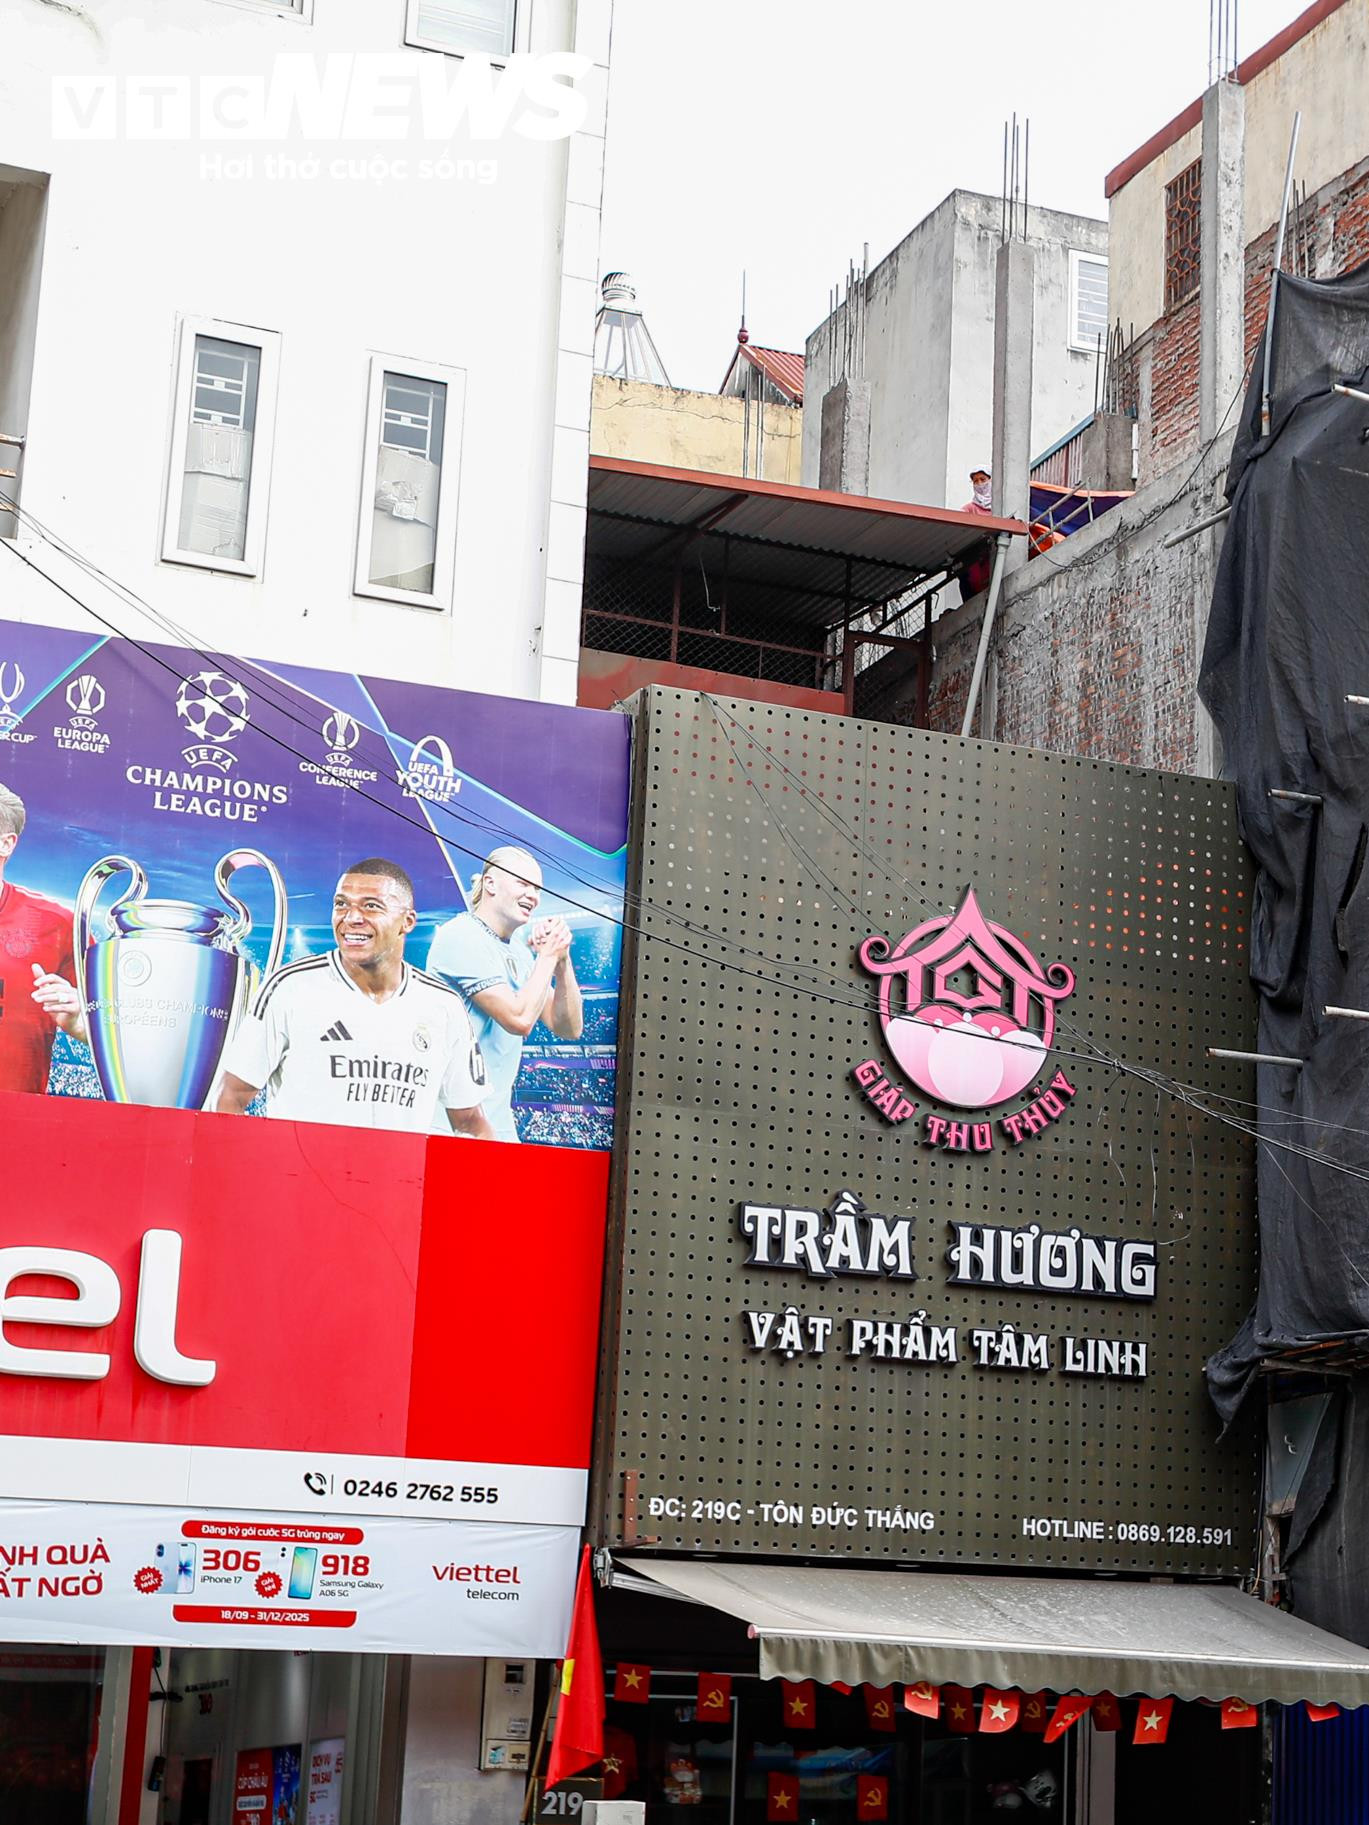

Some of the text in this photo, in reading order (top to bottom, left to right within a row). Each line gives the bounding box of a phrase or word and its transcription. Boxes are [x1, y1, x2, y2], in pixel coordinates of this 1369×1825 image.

[53, 727, 111, 745] EUROPA
[184, 748, 233, 771] UEFA
[299, 762, 378, 781] CONFERENCE
[408, 761, 439, 775] UEFA
[126, 765, 288, 804] CHAMPIONS
[395, 770, 463, 794] YOUTH
[330, 1054, 430, 1087] Emirates
[347, 1083, 416, 1109] FLY BETTER
[854, 1058, 1078, 1152] GIÁP THU THỦY
[742, 1191, 1158, 1298] TRẦM HƯƠNG
[745, 1306, 1148, 1378] VẬT PHẨM TÂM LINH
[343, 1479, 499, 1504] 0246 2762 555
[649, 1497, 686, 1518] ĐC:
[691, 1499, 742, 1521] 219C
[760, 1500, 804, 1525] TÔN
[811, 1501, 859, 1527] ĐỨC
[864, 1504, 935, 1530] THẮNG
[201, 1524, 227, 1536] Đăng
[228, 1526, 240, 1537] ký
[281, 1528, 296, 1538] 5G
[322, 1531, 345, 1542] ngay
[1022, 1518, 1105, 1540] HOTLINE
[1117, 1523, 1232, 1546] 0869.128.591
[0, 1537, 111, 1566] NH QUÀ
[202, 1549, 262, 1573] 306
[321, 1553, 371, 1577] 918
[432, 1562, 521, 1584] viettel
[0, 1566, 104, 1598] ẤT NGỜ
[200, 1575, 243, 1584] iPhone 17
[319, 1579, 385, 1590] Samsung Galaxy
[319, 1589, 349, 1598] A06 5G
[466, 1588, 520, 1601] telecom
[220, 1609, 249, 1621] 18/09
[256, 1611, 310, 1623] 31/12/2025
[541, 1791, 584, 1816] 219
